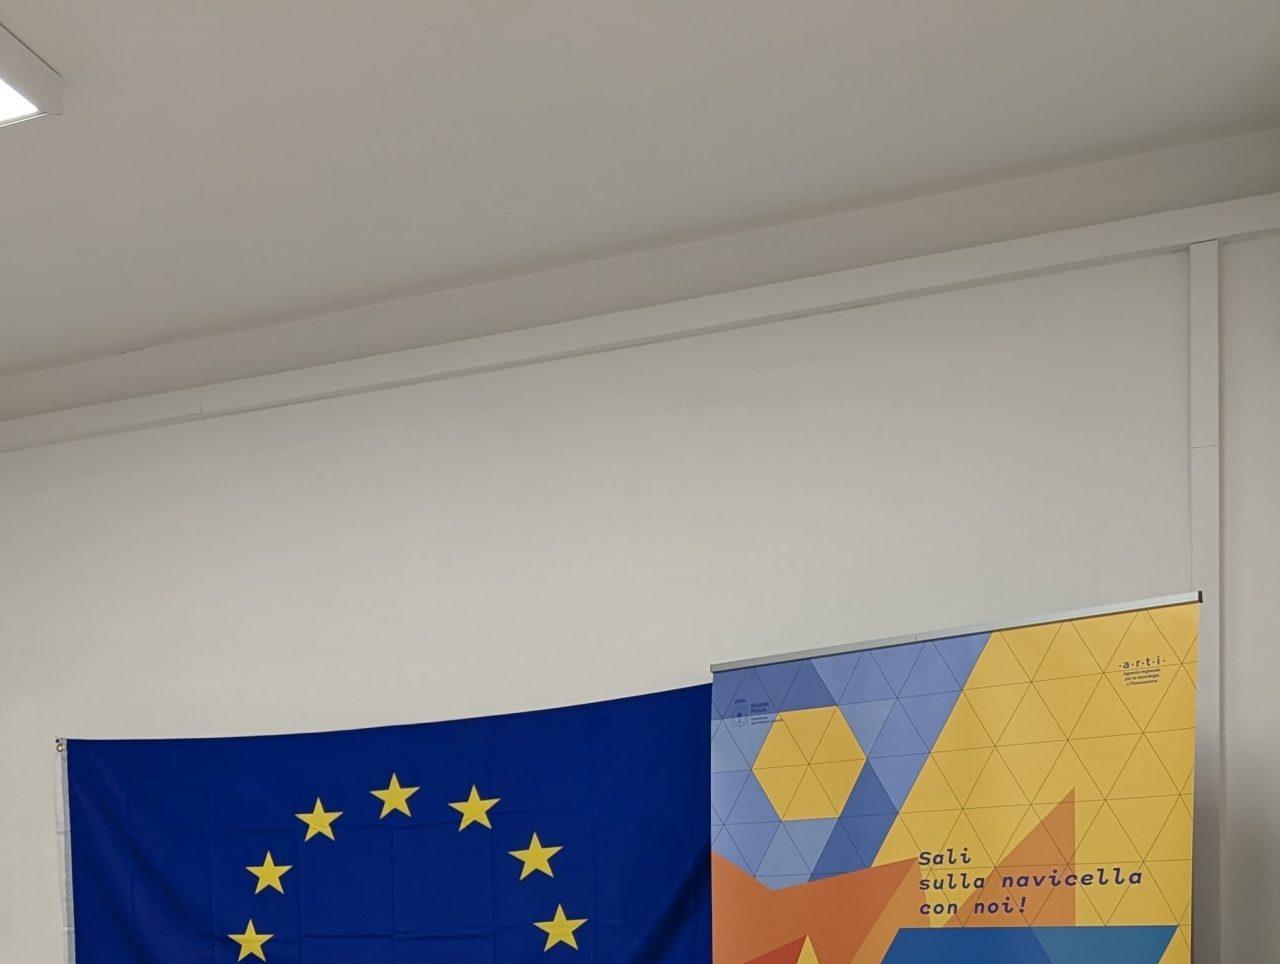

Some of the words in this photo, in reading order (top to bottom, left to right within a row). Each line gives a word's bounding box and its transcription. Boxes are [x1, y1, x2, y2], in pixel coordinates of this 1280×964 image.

[919, 847, 971, 865] Sali
[919, 873, 985, 890] sulla
[1002, 867, 1143, 888] navicella
[919, 902, 958, 914] con
[974, 896, 1027, 914] noi!
